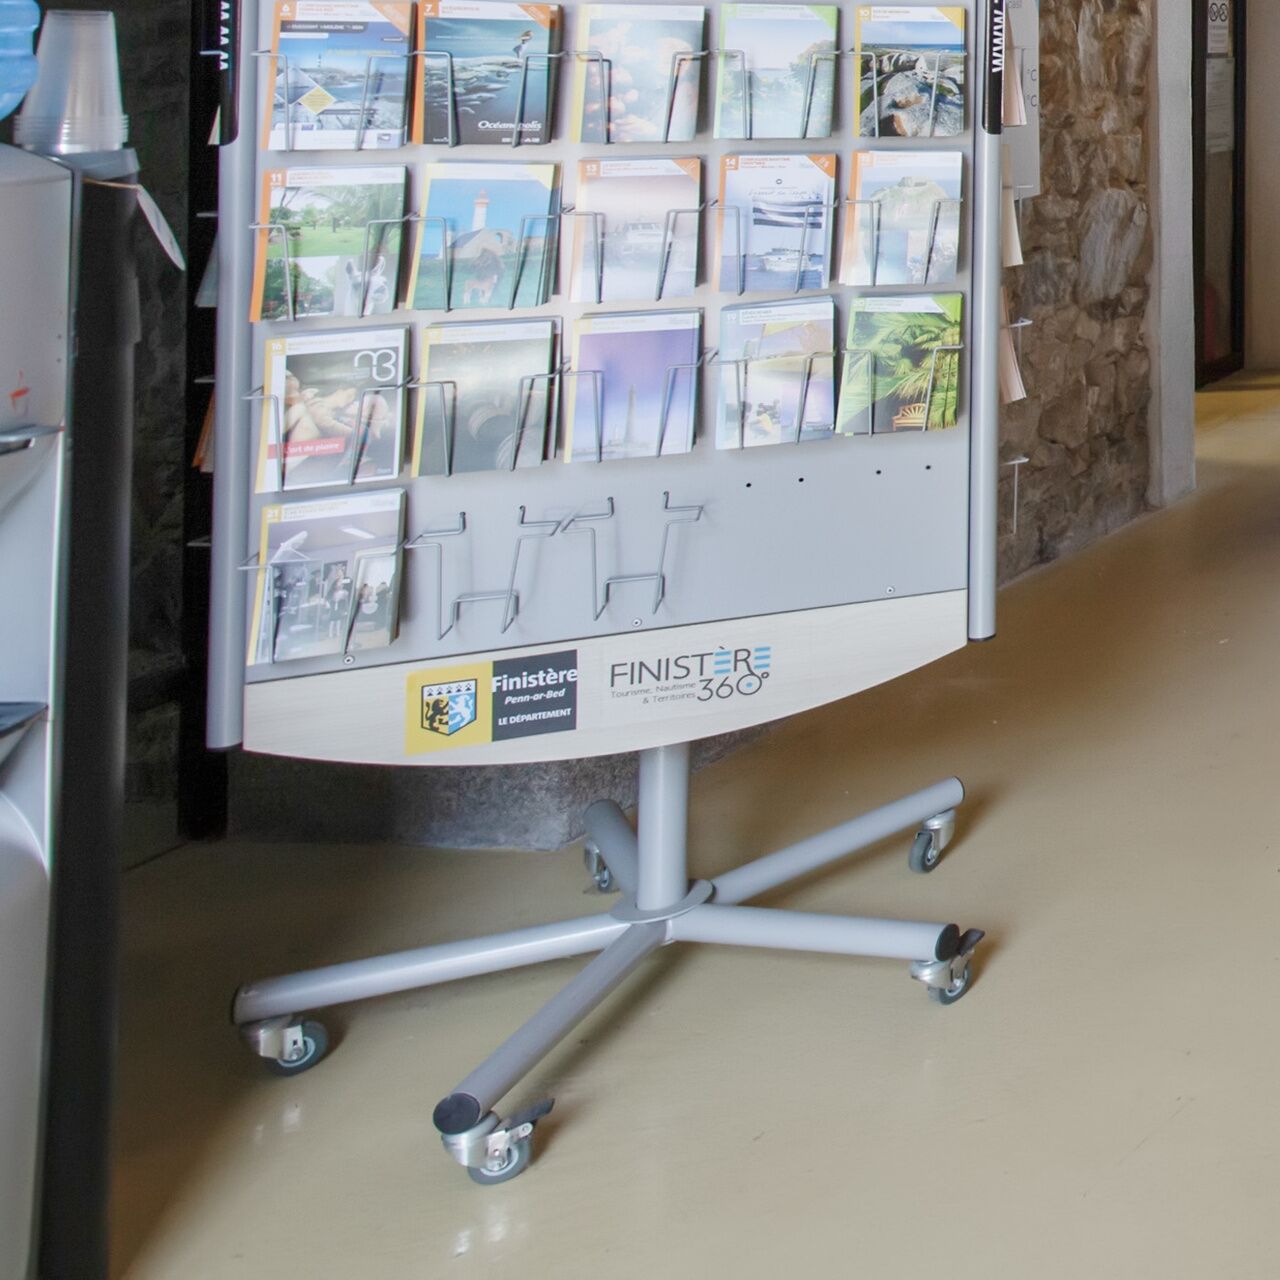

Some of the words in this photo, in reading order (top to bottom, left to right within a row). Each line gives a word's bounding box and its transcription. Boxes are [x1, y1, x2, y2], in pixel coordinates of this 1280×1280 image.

[424, 4, 433, 12] 7
[478, 119, 542, 130] Océanpolis
[610, 645, 771, 688] FINISTÈRE
[492, 667, 578, 693] Finistère
[656, 682, 696, 693] Nautisme
[697, 671, 770, 702] 360°
[504, 688, 566, 705] Penn-ar-Bed
[652, 691, 696, 704] Territoires
[498, 716, 508, 726] LE
[509, 708, 571, 724] DÉPARTEMENT
